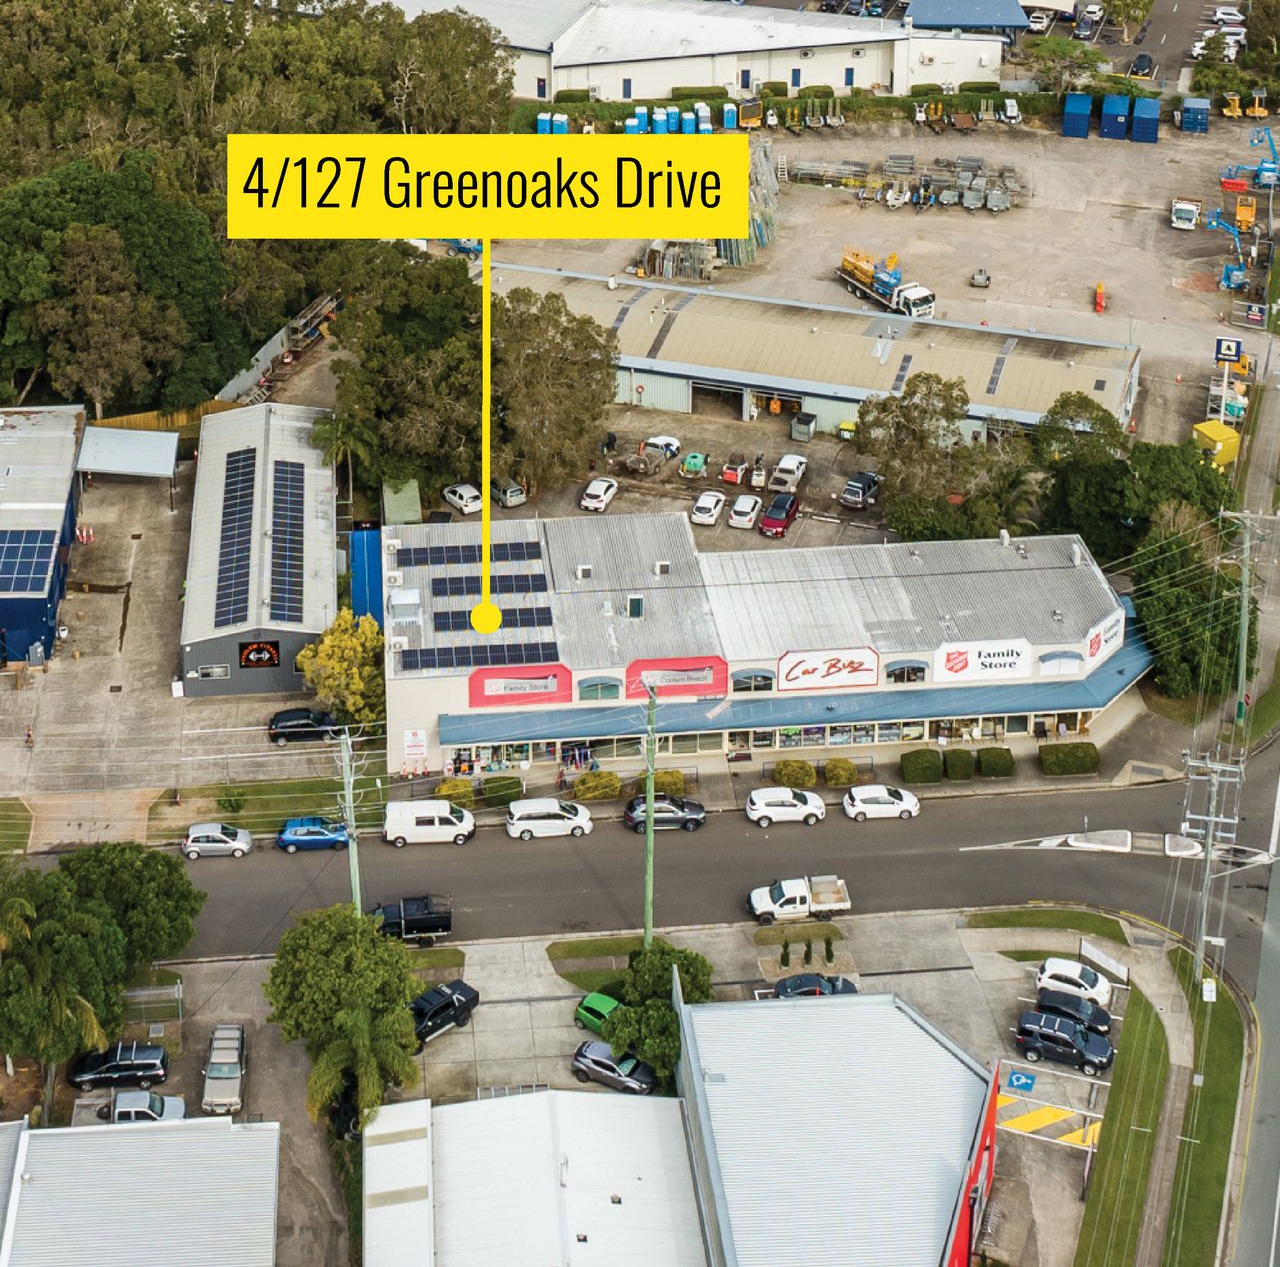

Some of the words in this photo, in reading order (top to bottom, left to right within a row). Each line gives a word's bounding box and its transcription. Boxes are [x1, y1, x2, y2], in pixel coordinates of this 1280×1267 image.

[977, 649, 1023, 660] Family
[980, 661, 1017, 670] Store
[785, 660, 818, 682] Car
[503, 683, 528, 692] Family
[529, 683, 549, 692] Store
